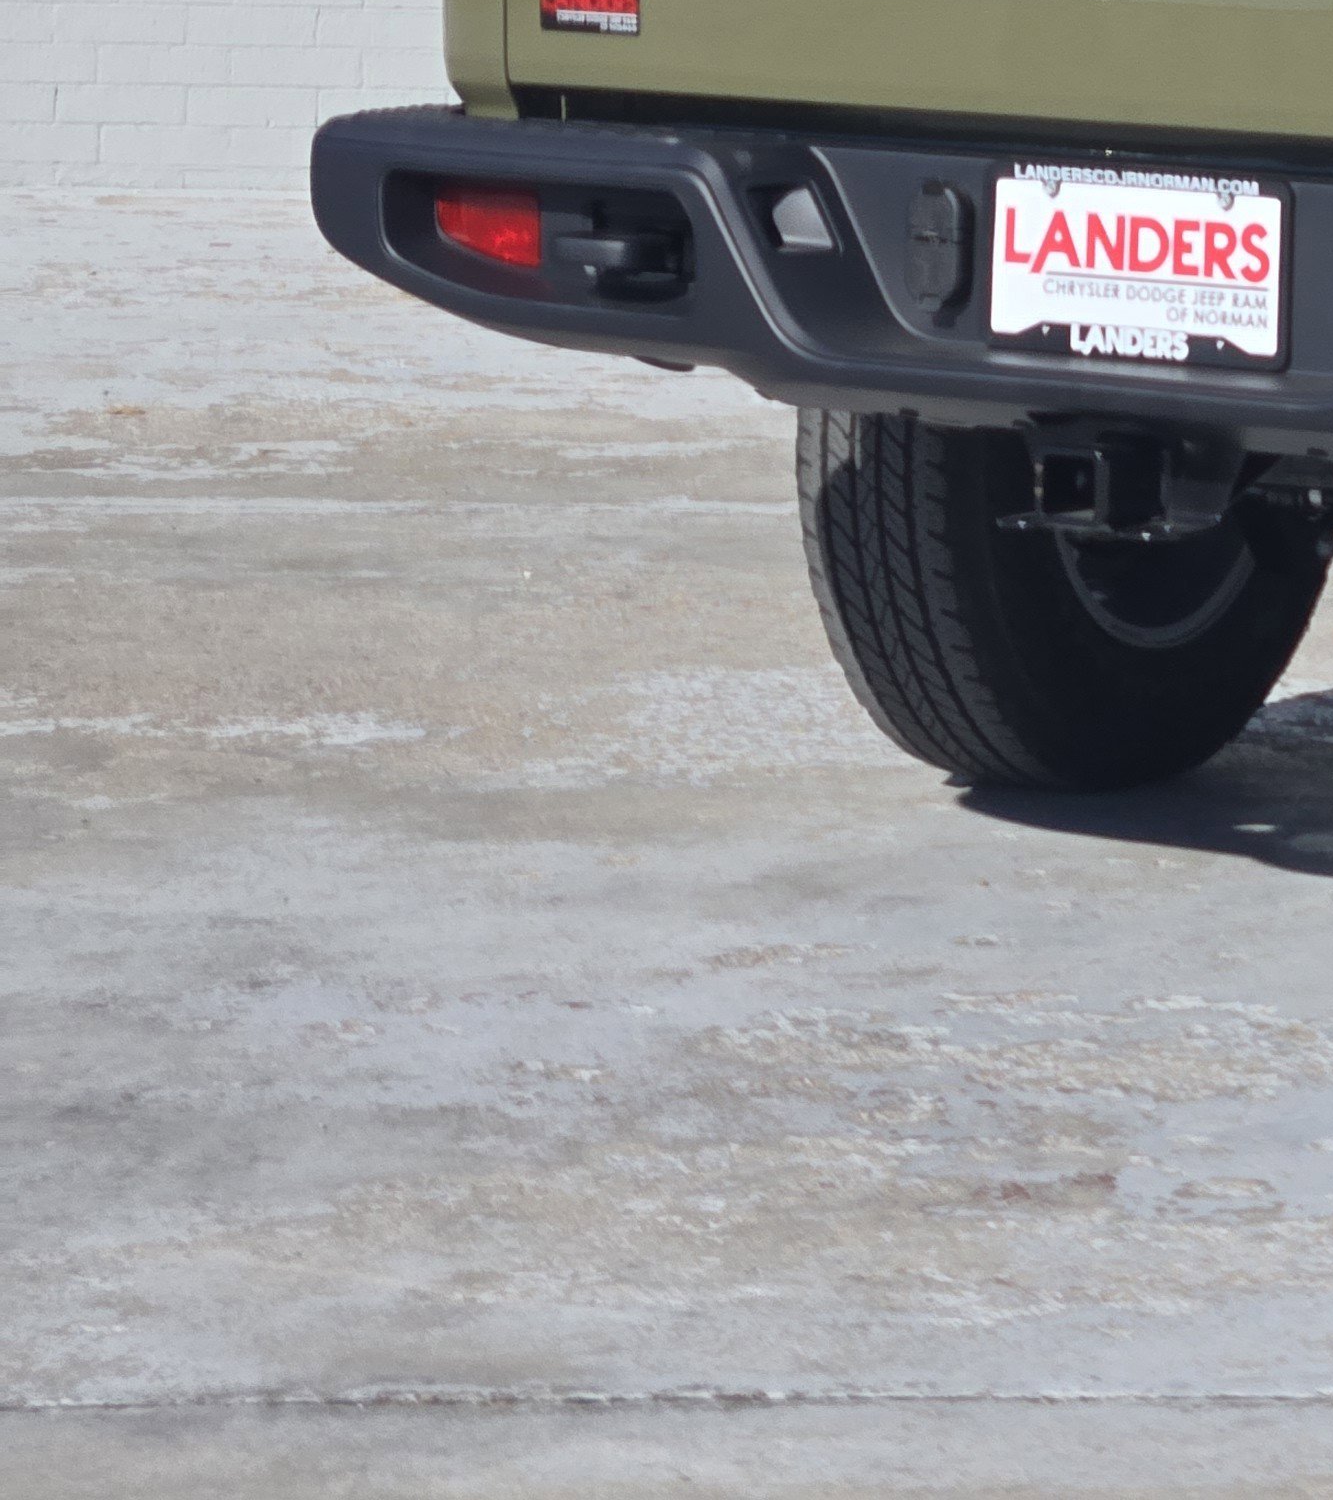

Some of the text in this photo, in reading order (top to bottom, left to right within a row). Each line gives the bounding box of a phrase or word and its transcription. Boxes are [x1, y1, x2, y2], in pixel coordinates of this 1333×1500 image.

[1014, 162, 1260, 196] LANDERSCDJRNORMAN.COM
[1004, 207, 1270, 283] LANDERS
[1042, 278, 1268, 311] CHRYSLER DODGE JEEP RAM
[1165, 306, 1269, 330] OF NORMAN
[1070, 323, 1190, 361] LANDERS
